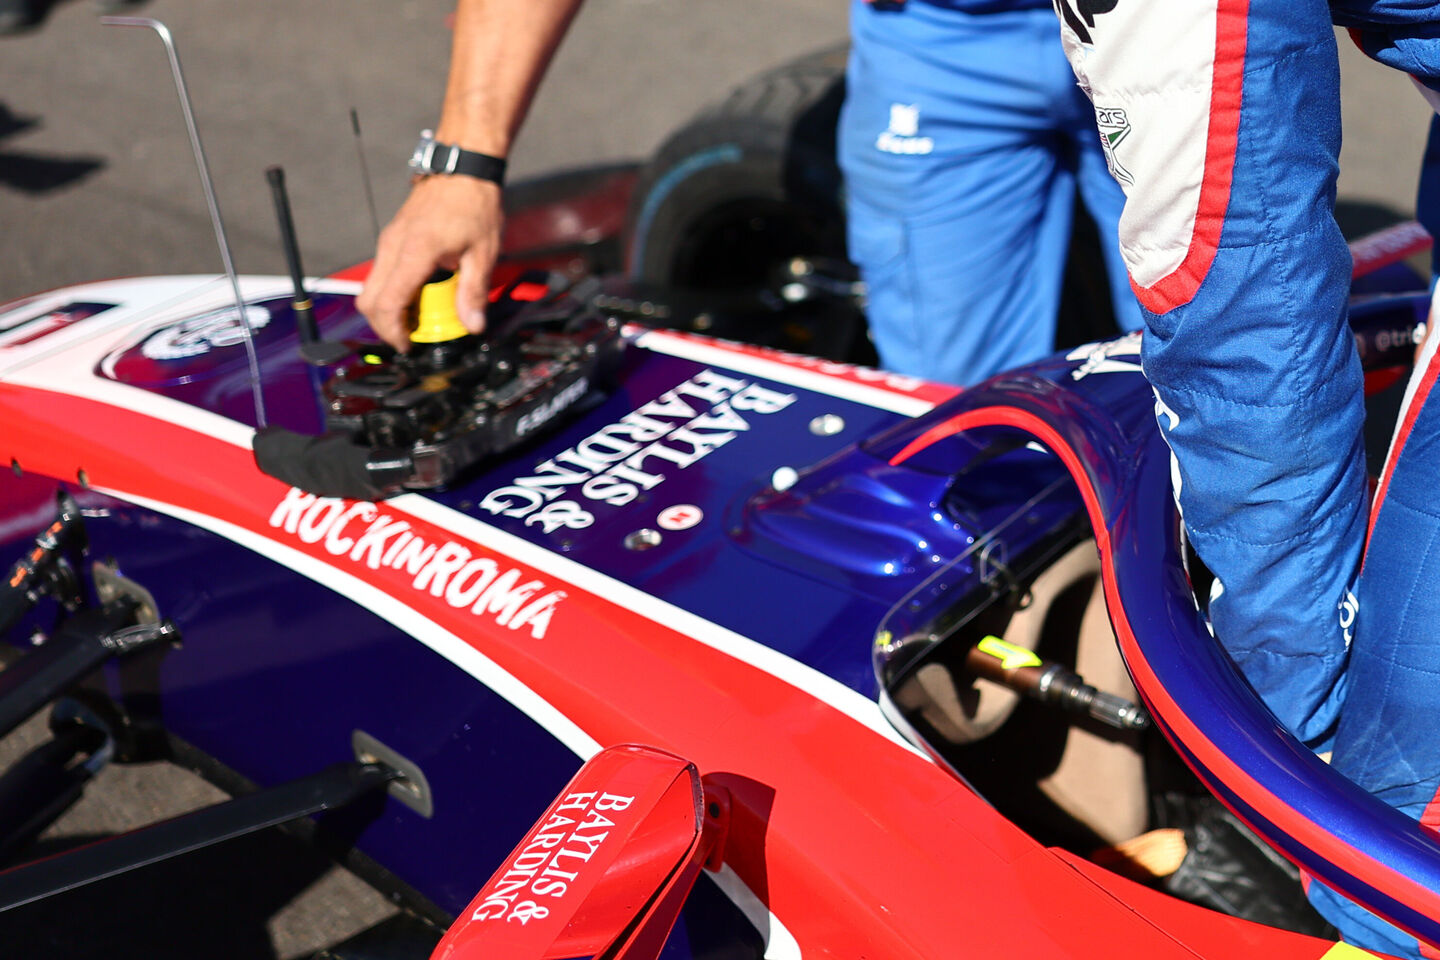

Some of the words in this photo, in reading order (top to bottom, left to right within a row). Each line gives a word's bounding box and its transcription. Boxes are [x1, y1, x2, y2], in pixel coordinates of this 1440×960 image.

[479, 369, 748, 519] HARDING
[582, 384, 798, 506] BAYLIS
[525, 500, 595, 534] &
[472, 791, 598, 922] HARDING
[531, 792, 635, 898] BAYLIS
[507, 900, 549, 926] &
